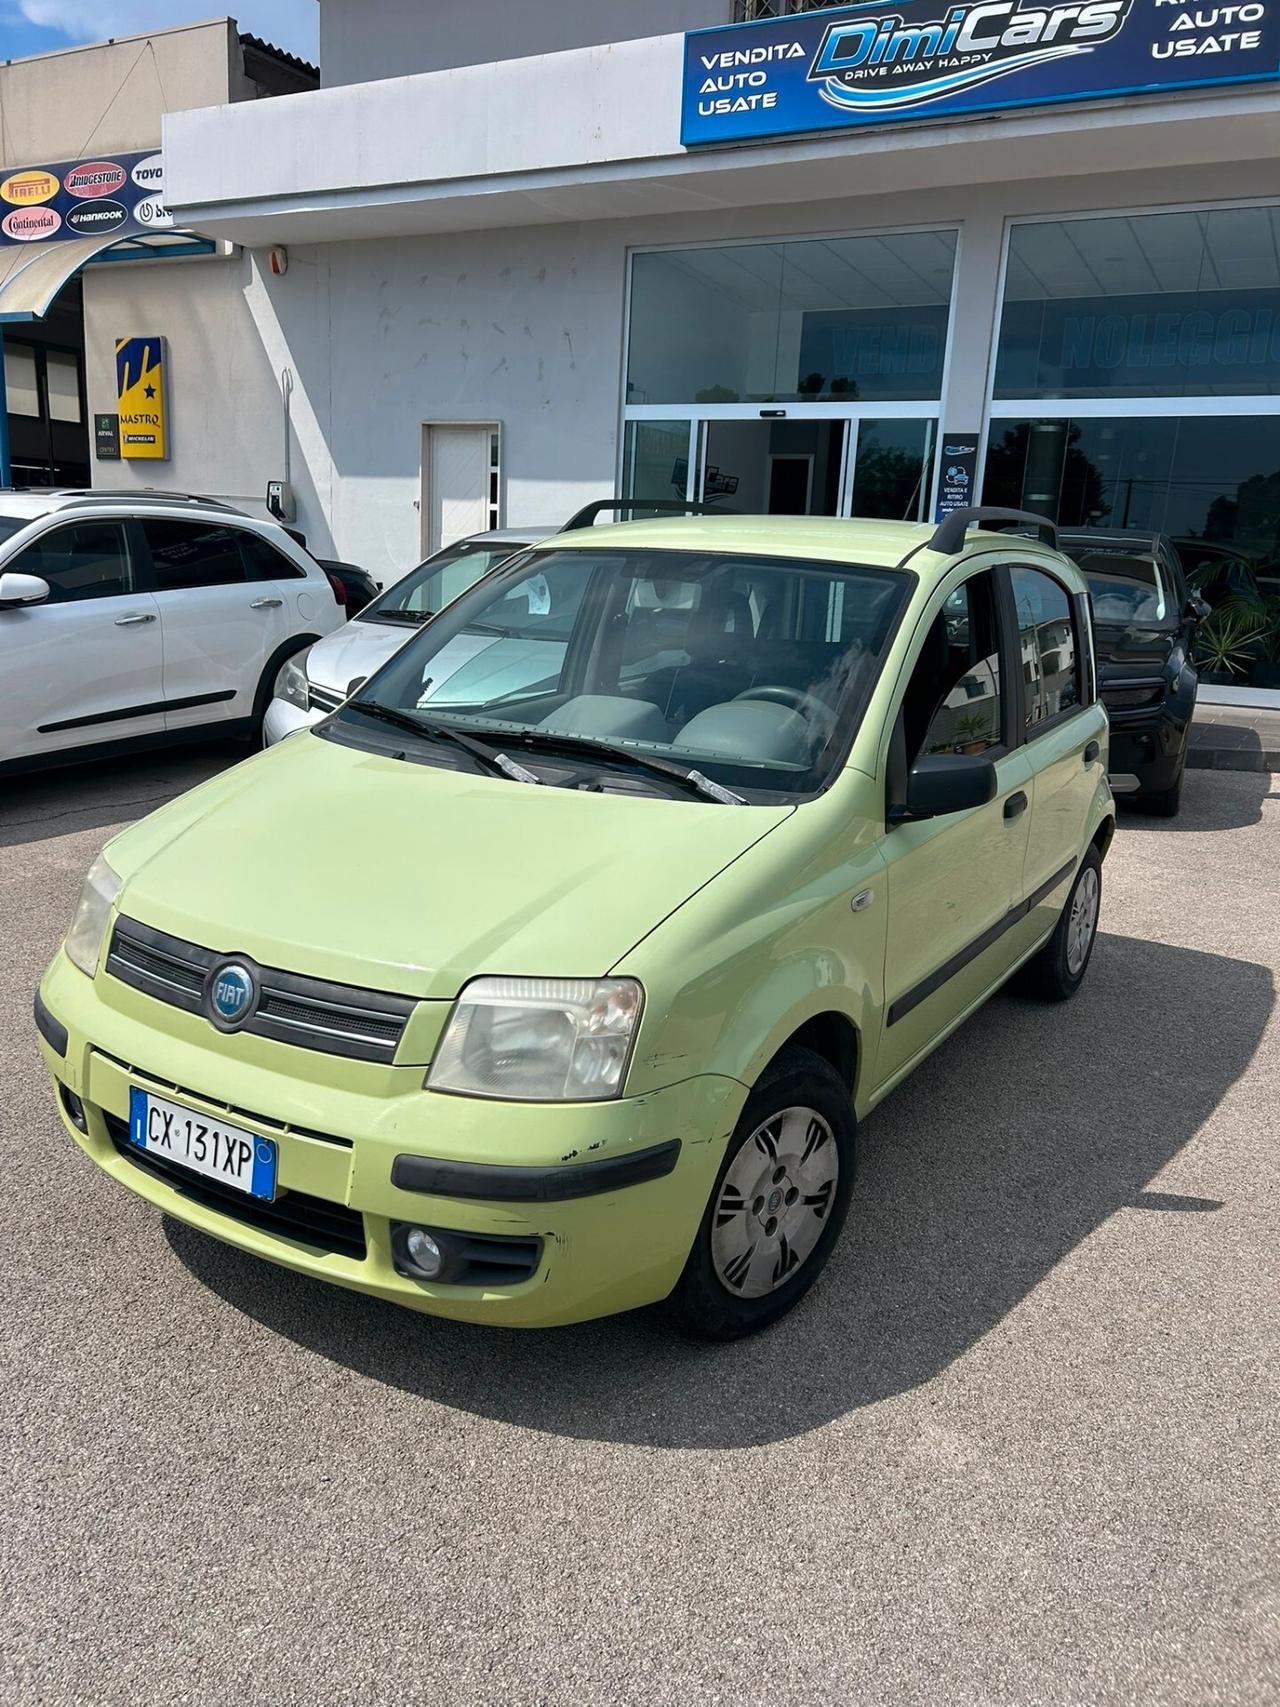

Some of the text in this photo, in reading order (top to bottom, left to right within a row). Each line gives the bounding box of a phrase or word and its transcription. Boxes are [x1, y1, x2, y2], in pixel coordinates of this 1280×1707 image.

[1169, 3, 1265, 31] AUTO
[815, 1, 1128, 72] DimiCars
[1152, 30, 1262, 59] USATE
[701, 42, 806, 70] VENDITA
[844, 52, 993, 81] DRIVE AWAY HAPPY
[699, 71, 767, 94] AUTO
[698, 92, 778, 116] USATE
[69, 170, 123, 188] BRIDGESTONE
[135, 168, 163, 180] TOYO
[8, 178, 51, 198] PIRELLI
[8, 215, 54, 233] Continental
[1059, 309, 1280, 369] NOLEGGI
[120, 414, 159, 424] MASTRO
[216, 982, 245, 1006] FIAT
[148, 1106, 252, 1177] CX 131XP
